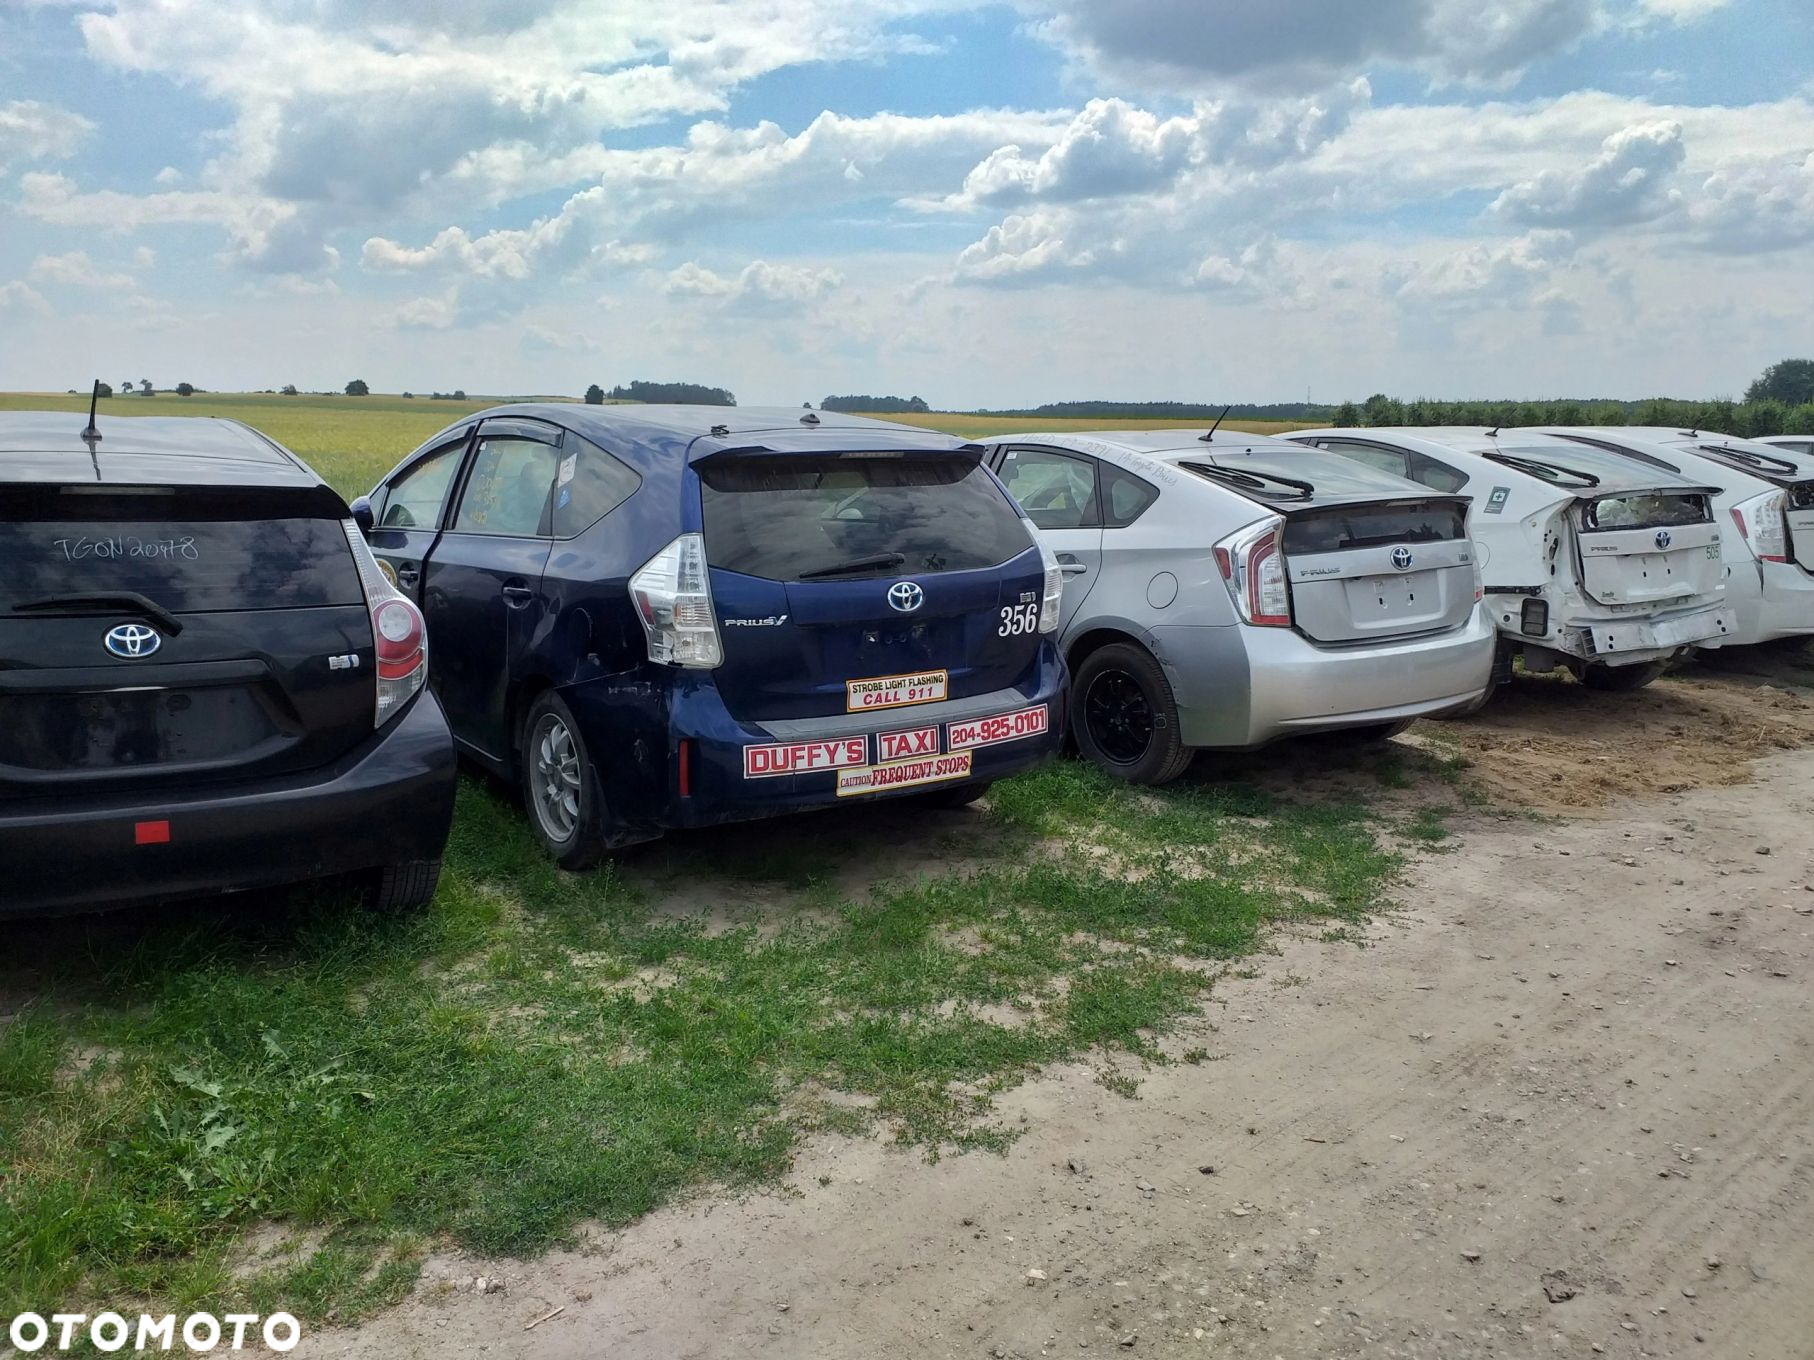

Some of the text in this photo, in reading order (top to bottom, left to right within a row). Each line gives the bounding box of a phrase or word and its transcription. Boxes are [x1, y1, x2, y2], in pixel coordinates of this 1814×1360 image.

[1706, 546, 1720, 560] 505
[998, 603, 1038, 637] 356
[852, 674, 944, 694] STROBE LIGHT FLASHING
[863, 686, 933, 705] CALL 911
[750, 709, 1045, 772] DUFFY'S TAXI 204-925-0101
[840, 755, 969, 788] CAUTION FREQUENT STOPS
